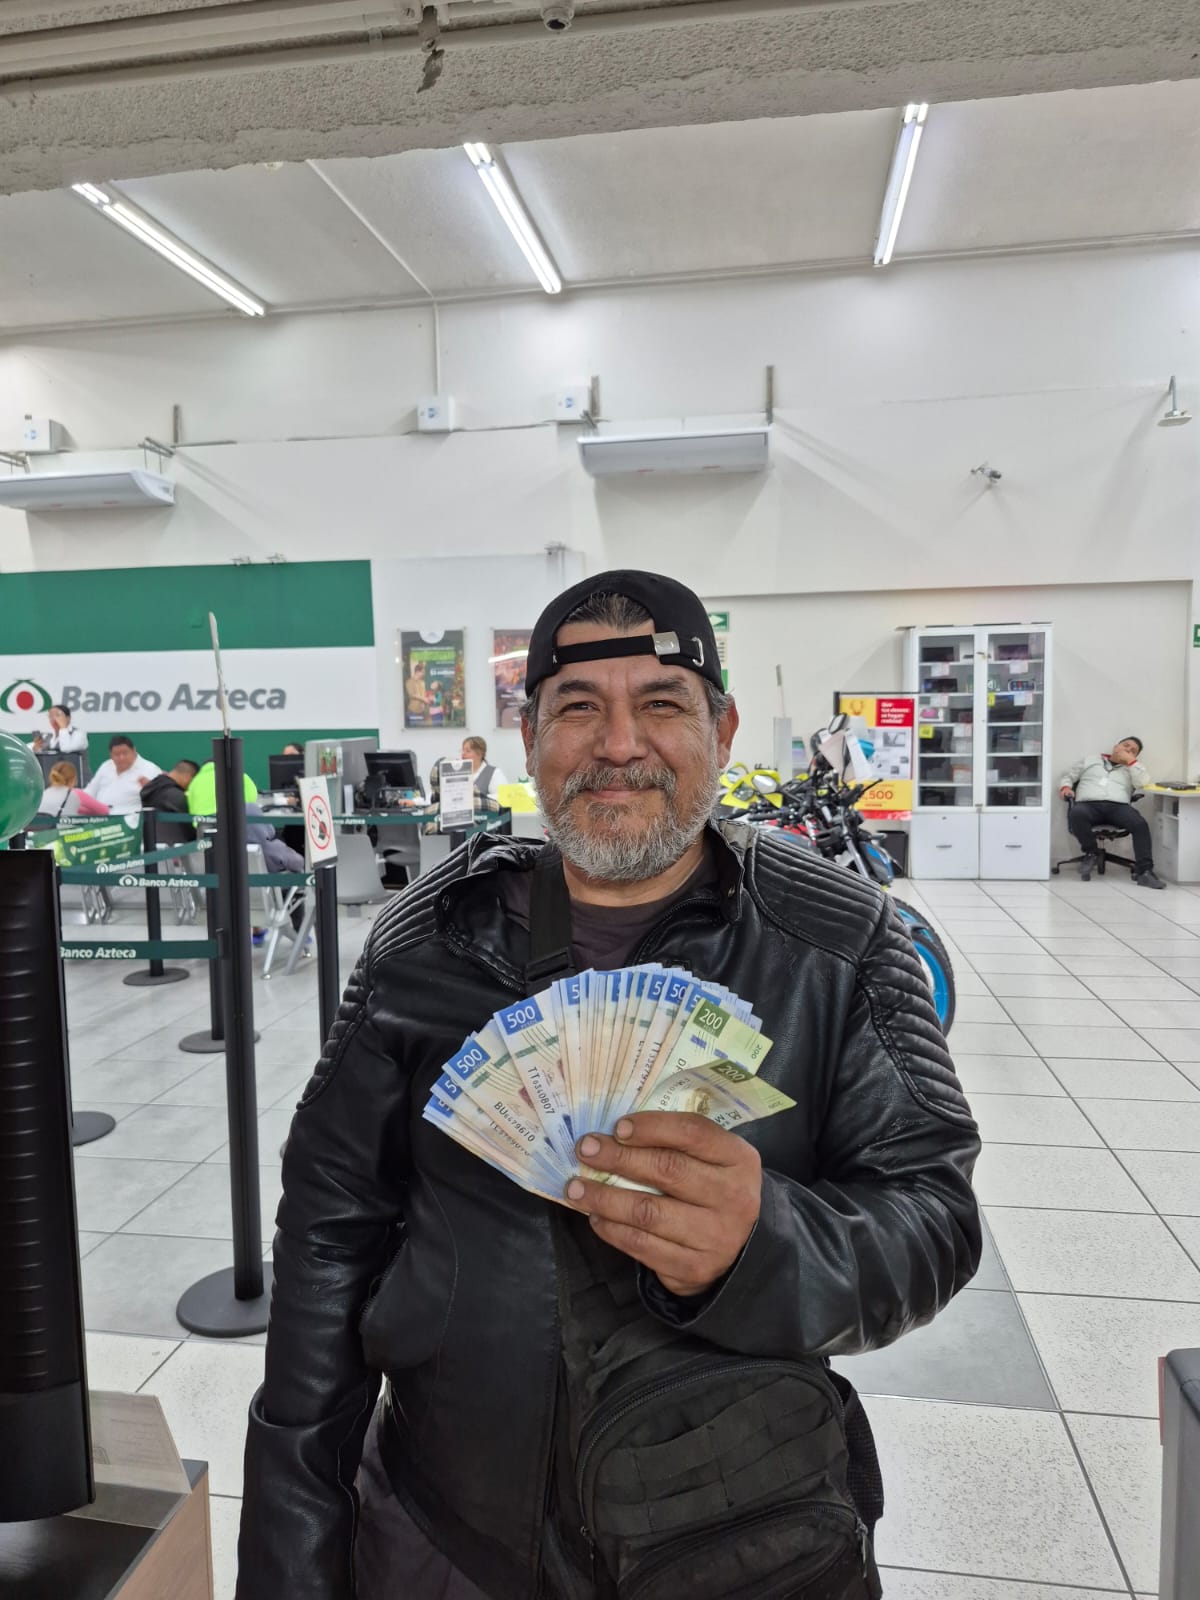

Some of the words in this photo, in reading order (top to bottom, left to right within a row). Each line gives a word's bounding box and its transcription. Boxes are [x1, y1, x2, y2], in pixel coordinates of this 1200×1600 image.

[60, 685, 162, 712] Banco
[138, 878, 167, 887] Banco
[168, 877, 199, 888] Azteca
[95, 946, 137, 959] Azteca
[507, 1005, 536, 1029] 500
[699, 1008, 723, 1030] 200
[456, 1048, 483, 1074] 500
[718, 1065, 745, 1080] 200
